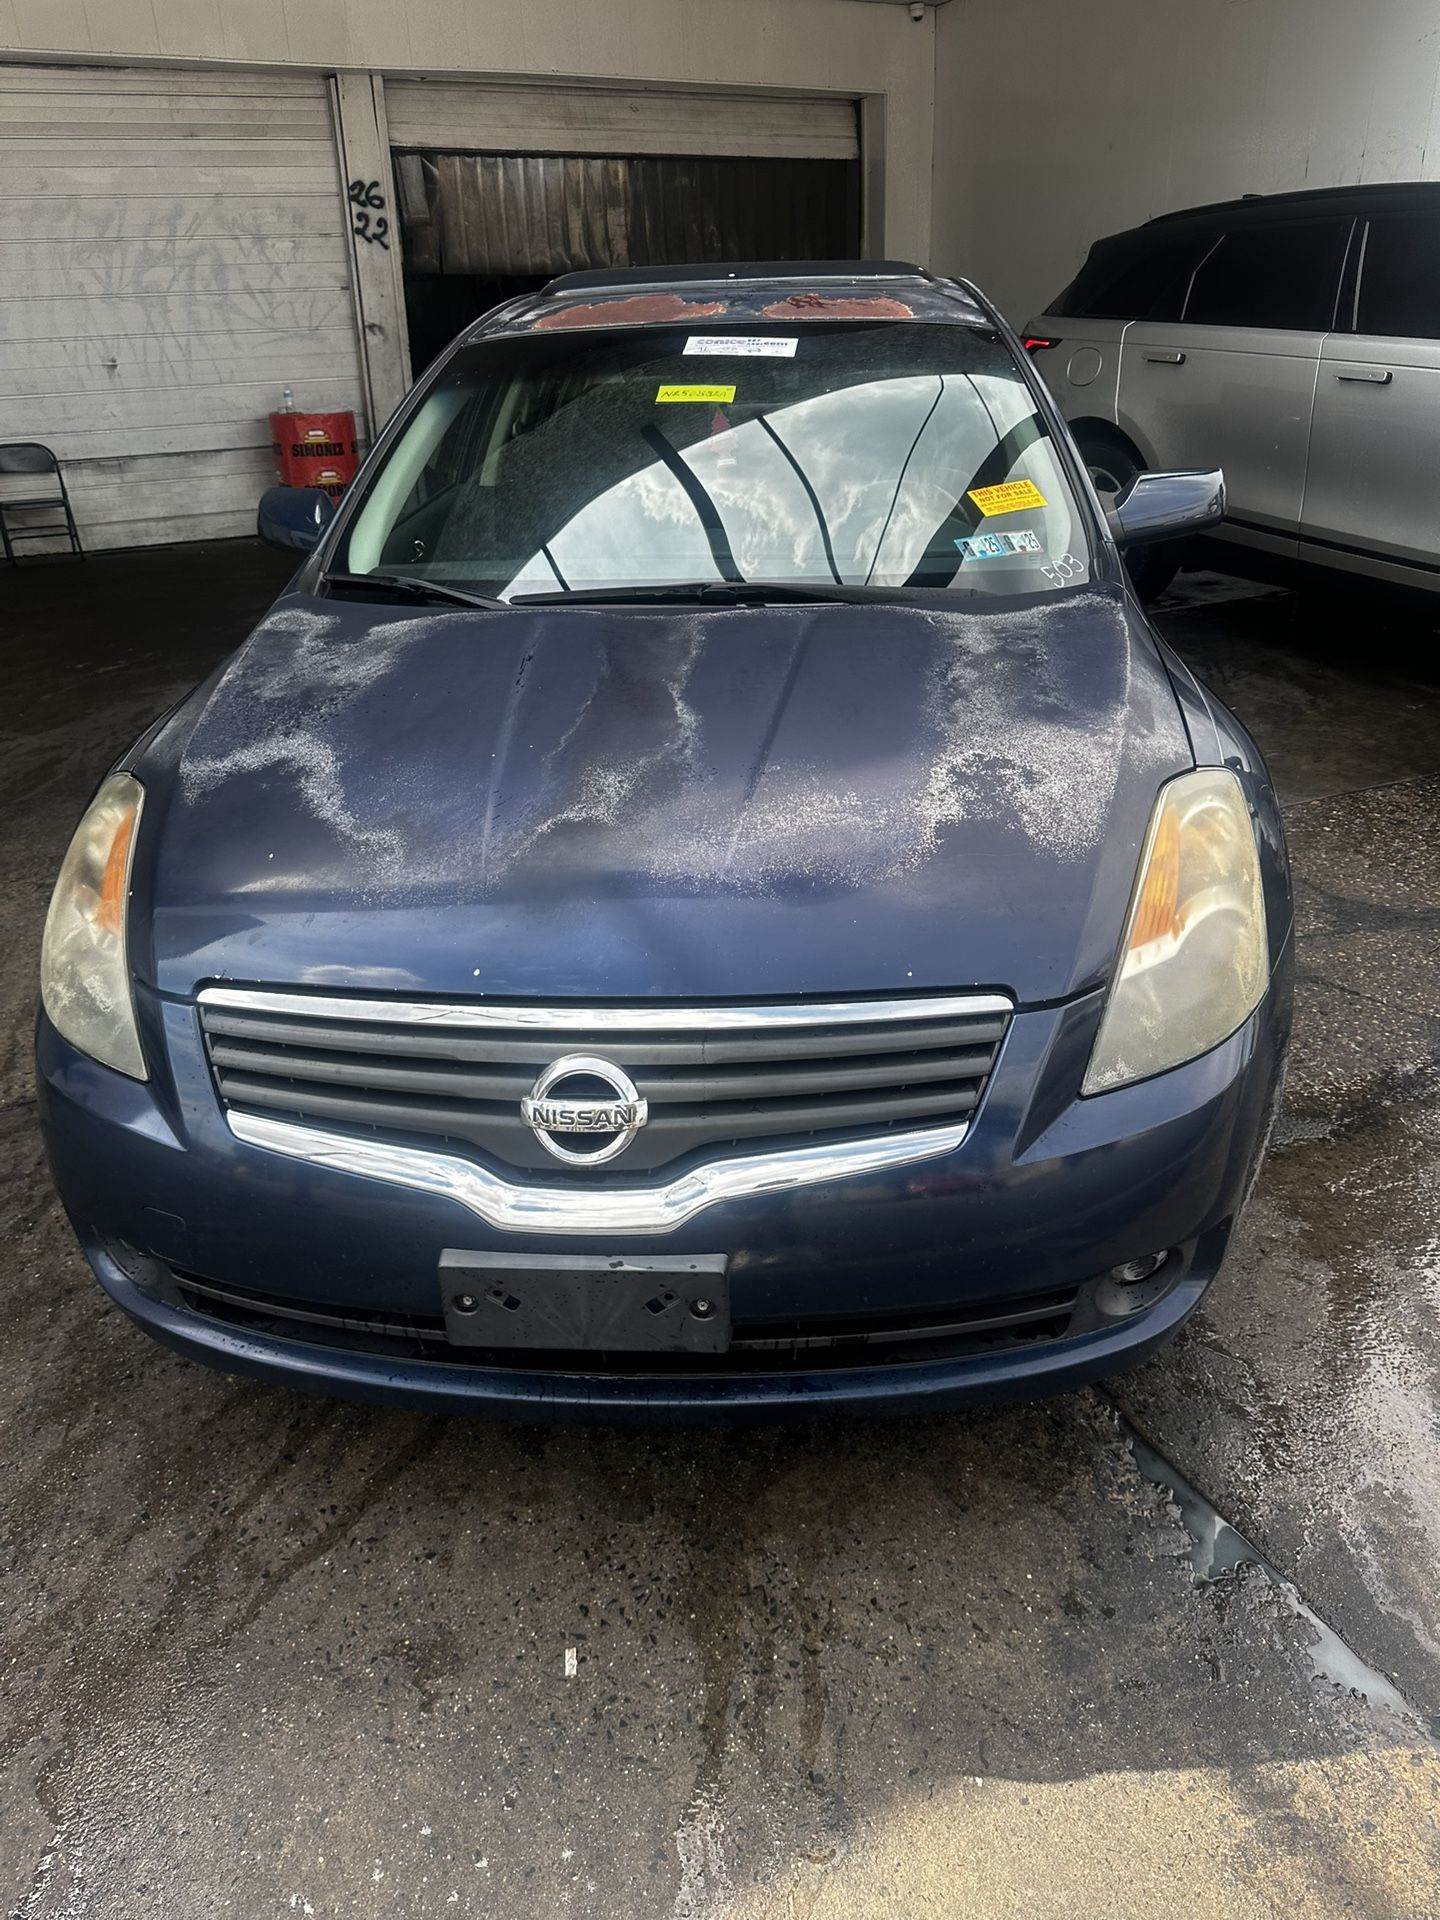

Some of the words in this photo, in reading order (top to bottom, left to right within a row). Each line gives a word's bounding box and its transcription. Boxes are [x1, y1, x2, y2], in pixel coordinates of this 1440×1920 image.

[350, 180, 385, 209] 26
[354, 212, 389, 250] 22
[292, 442, 345, 457] SIMONIZ
[972, 489, 993, 498] THIS
[995, 481, 1031, 492] VEHICLE
[1014, 488, 1033, 496] SALE
[984, 536, 1001, 553] 25
[1024, 532, 1040, 549] 25
[1040, 552, 1084, 588] 503
[532, 1106, 633, 1126] NISSAN
